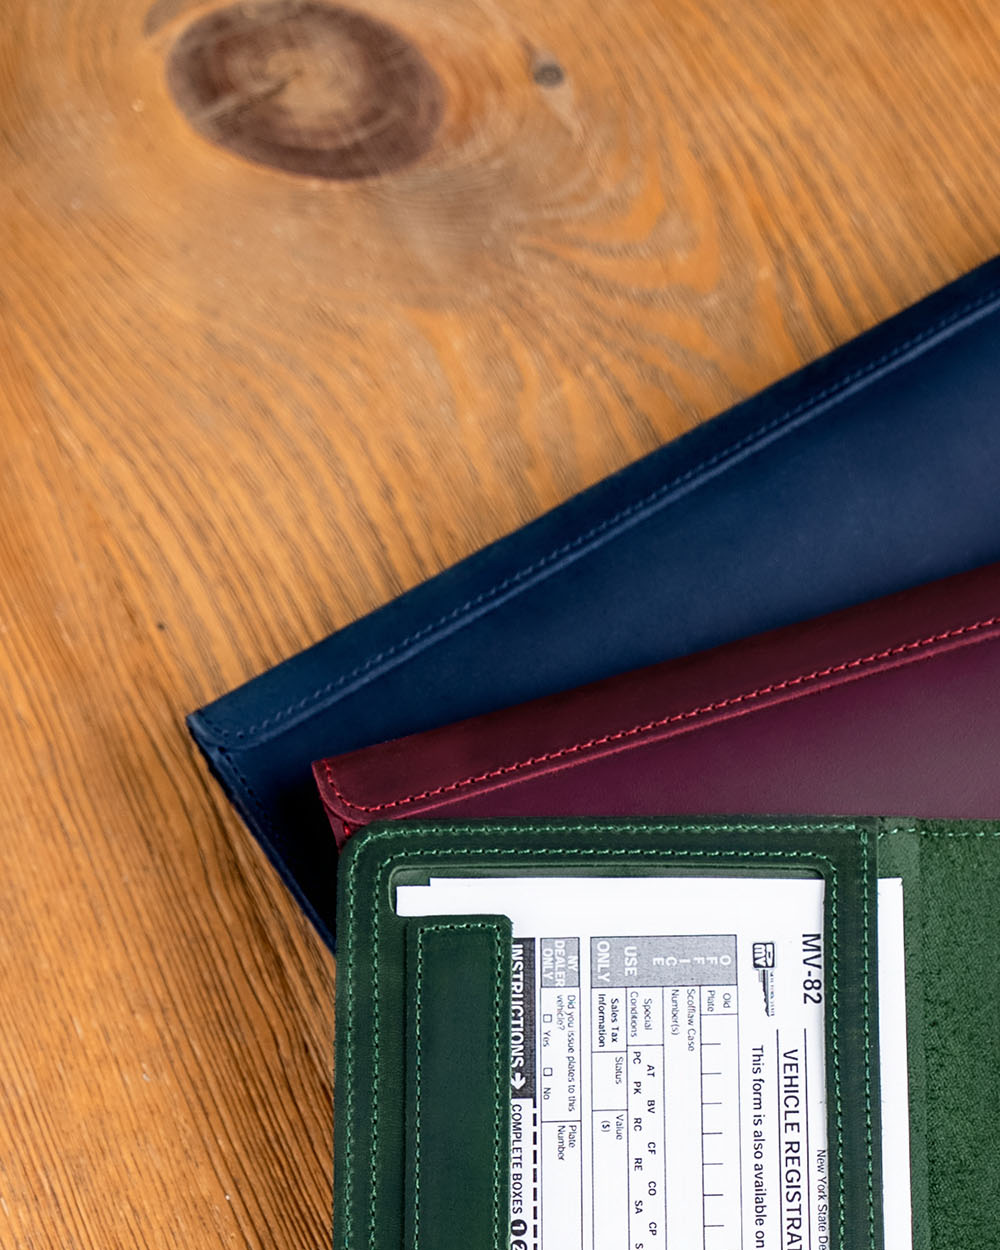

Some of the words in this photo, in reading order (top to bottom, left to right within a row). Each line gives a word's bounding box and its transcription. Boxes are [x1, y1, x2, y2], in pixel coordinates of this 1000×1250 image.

[542, 949, 553, 980] ONLY
[554, 940, 565, 986] DEALER
[567, 955, 578, 971] NY
[596, 941, 610, 982] ONLY
[623, 946, 637, 977] USE
[802, 933, 822, 1005] MV-82
[511, 943, 524, 1067] INSTRUCTIONS
[556, 995, 566, 1030] vehicle?
[567, 995, 576, 1009] Did
[611, 998, 620, 1024] Sales
[669, 988, 680, 1035] Number(s)
[706, 990, 716, 1012] Plate
[722, 993, 732, 1008] Old
[565, 1011, 573, 1028] you
[598, 993, 607, 1047] Information
[630, 991, 639, 1037] Conditions
[543, 1031, 551, 1047] Yes
[611, 1027, 620, 1043] Tax
[566, 1056, 576, 1082] plates
[615, 1056, 624, 1084] Status
[633, 1051, 642, 1065] PC
[752, 1045, 764, 1074] This
[647, 1064, 655, 1077] AT
[543, 1087, 551, 1100] No
[567, 1085, 576, 1094] to
[633, 1081, 642, 1095] PK
[752, 1078, 765, 1111] form
[783, 1049, 800, 1134] VEHICLE
[568, 1096, 576, 1112] this
[647, 1100, 655, 1114] BV
[615, 1114, 624, 1140] Value
[633, 1118, 642, 1132] RC
[753, 1114, 765, 1126] is
[512, 1104, 523, 1168] COMPLETE
[557, 1125, 566, 1160] Number
[568, 1125, 577, 1148] Plate
[753, 1130, 766, 1160] also
[648, 1142, 656, 1155] CF
[634, 1158, 642, 1171] RE
[817, 1149, 826, 1173] New
[512, 1173, 524, 1214] BOXES
[648, 1181, 656, 1196] CO
[754, 1163, 767, 1226] available
[817, 1176, 827, 1201] York
[634, 1200, 643, 1214] SA
[818, 1204, 827, 1232] State
[648, 1222, 657, 1236] CP
[755, 1230, 765, 1248] on
